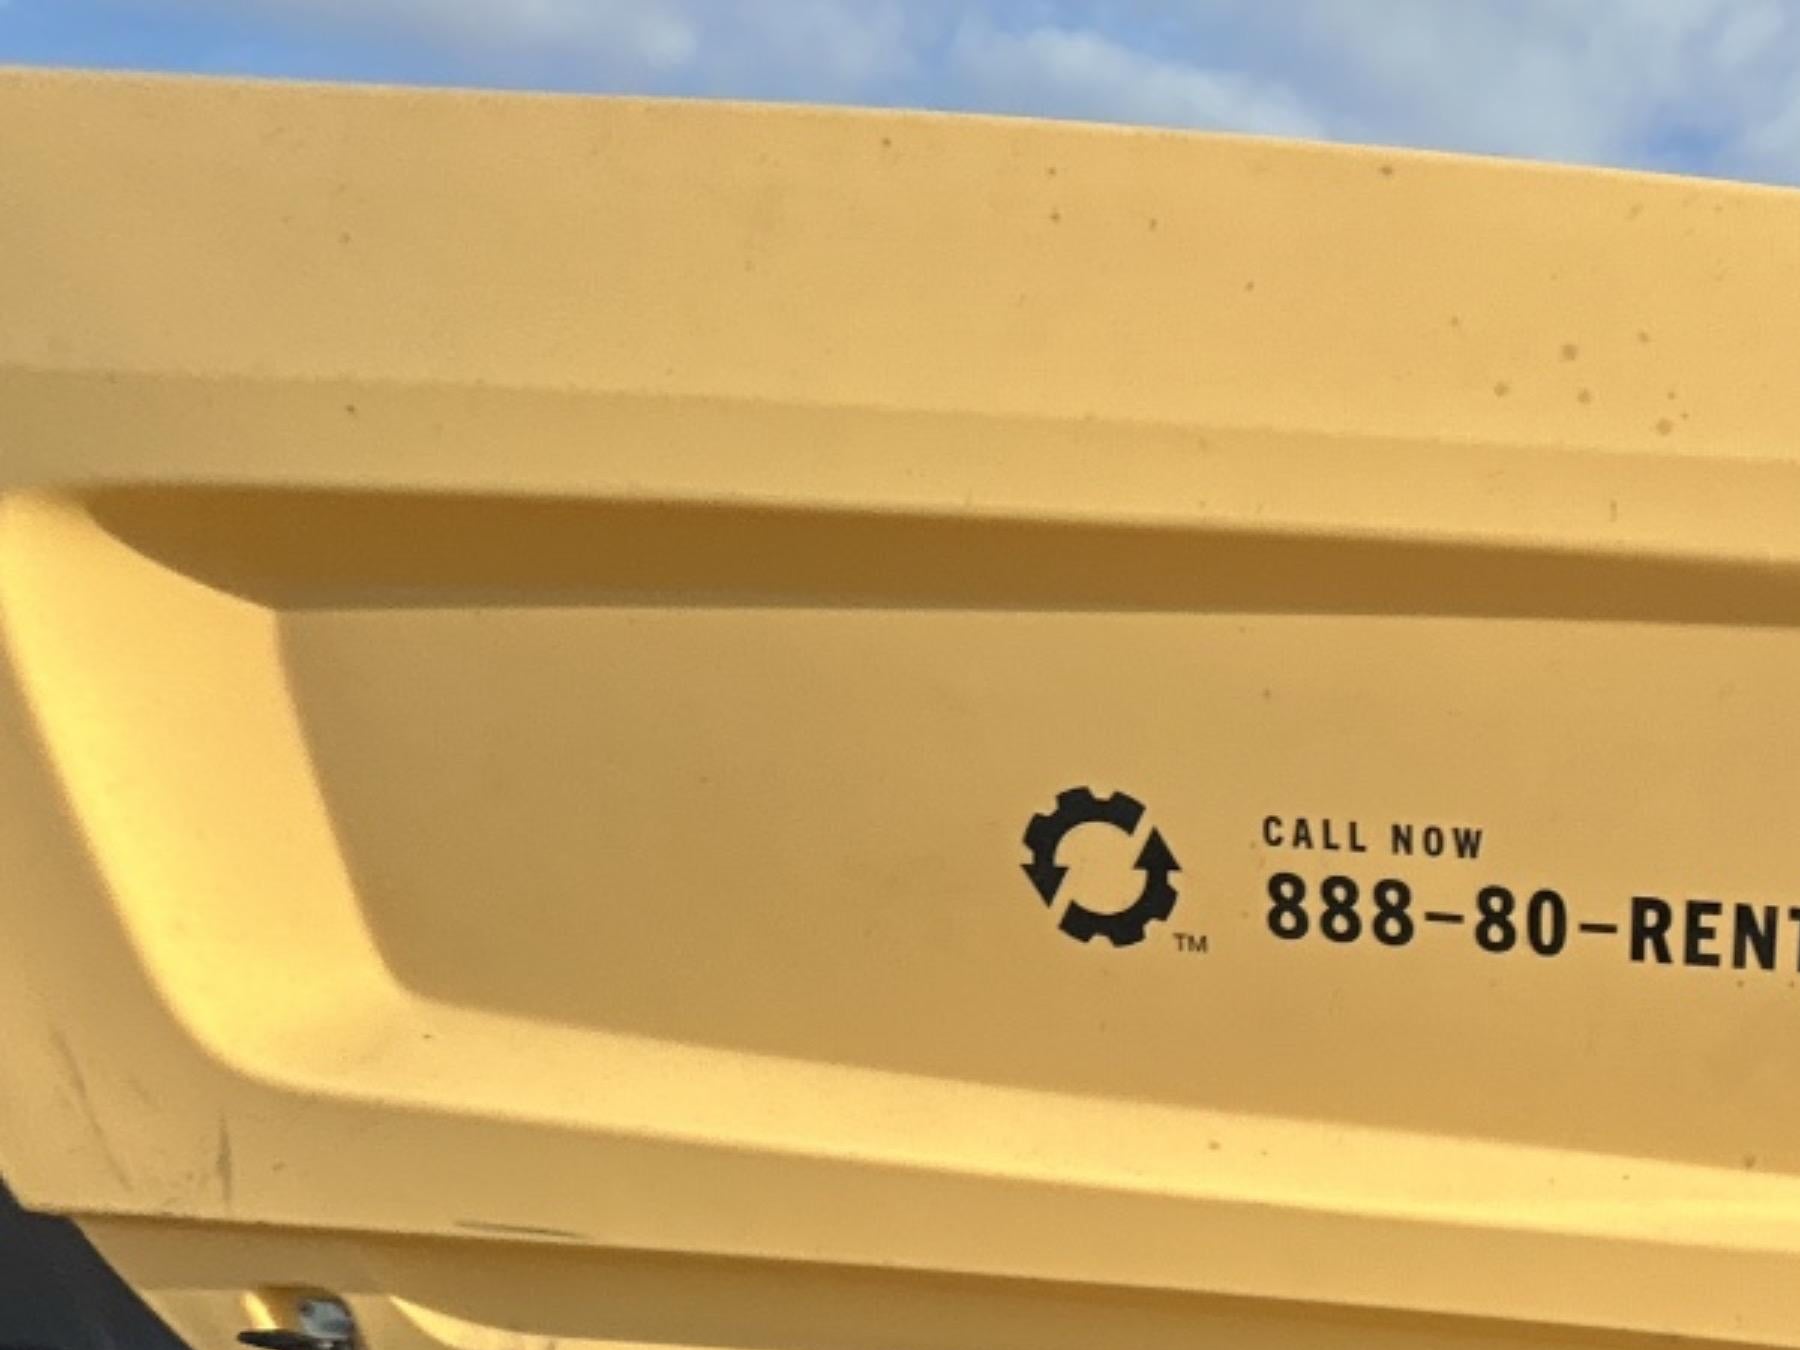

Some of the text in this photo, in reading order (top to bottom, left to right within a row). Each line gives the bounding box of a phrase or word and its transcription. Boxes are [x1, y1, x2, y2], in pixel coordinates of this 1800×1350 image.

[1262, 815, 1484, 859] CALL NOW
[1173, 932, 1208, 953] TM
